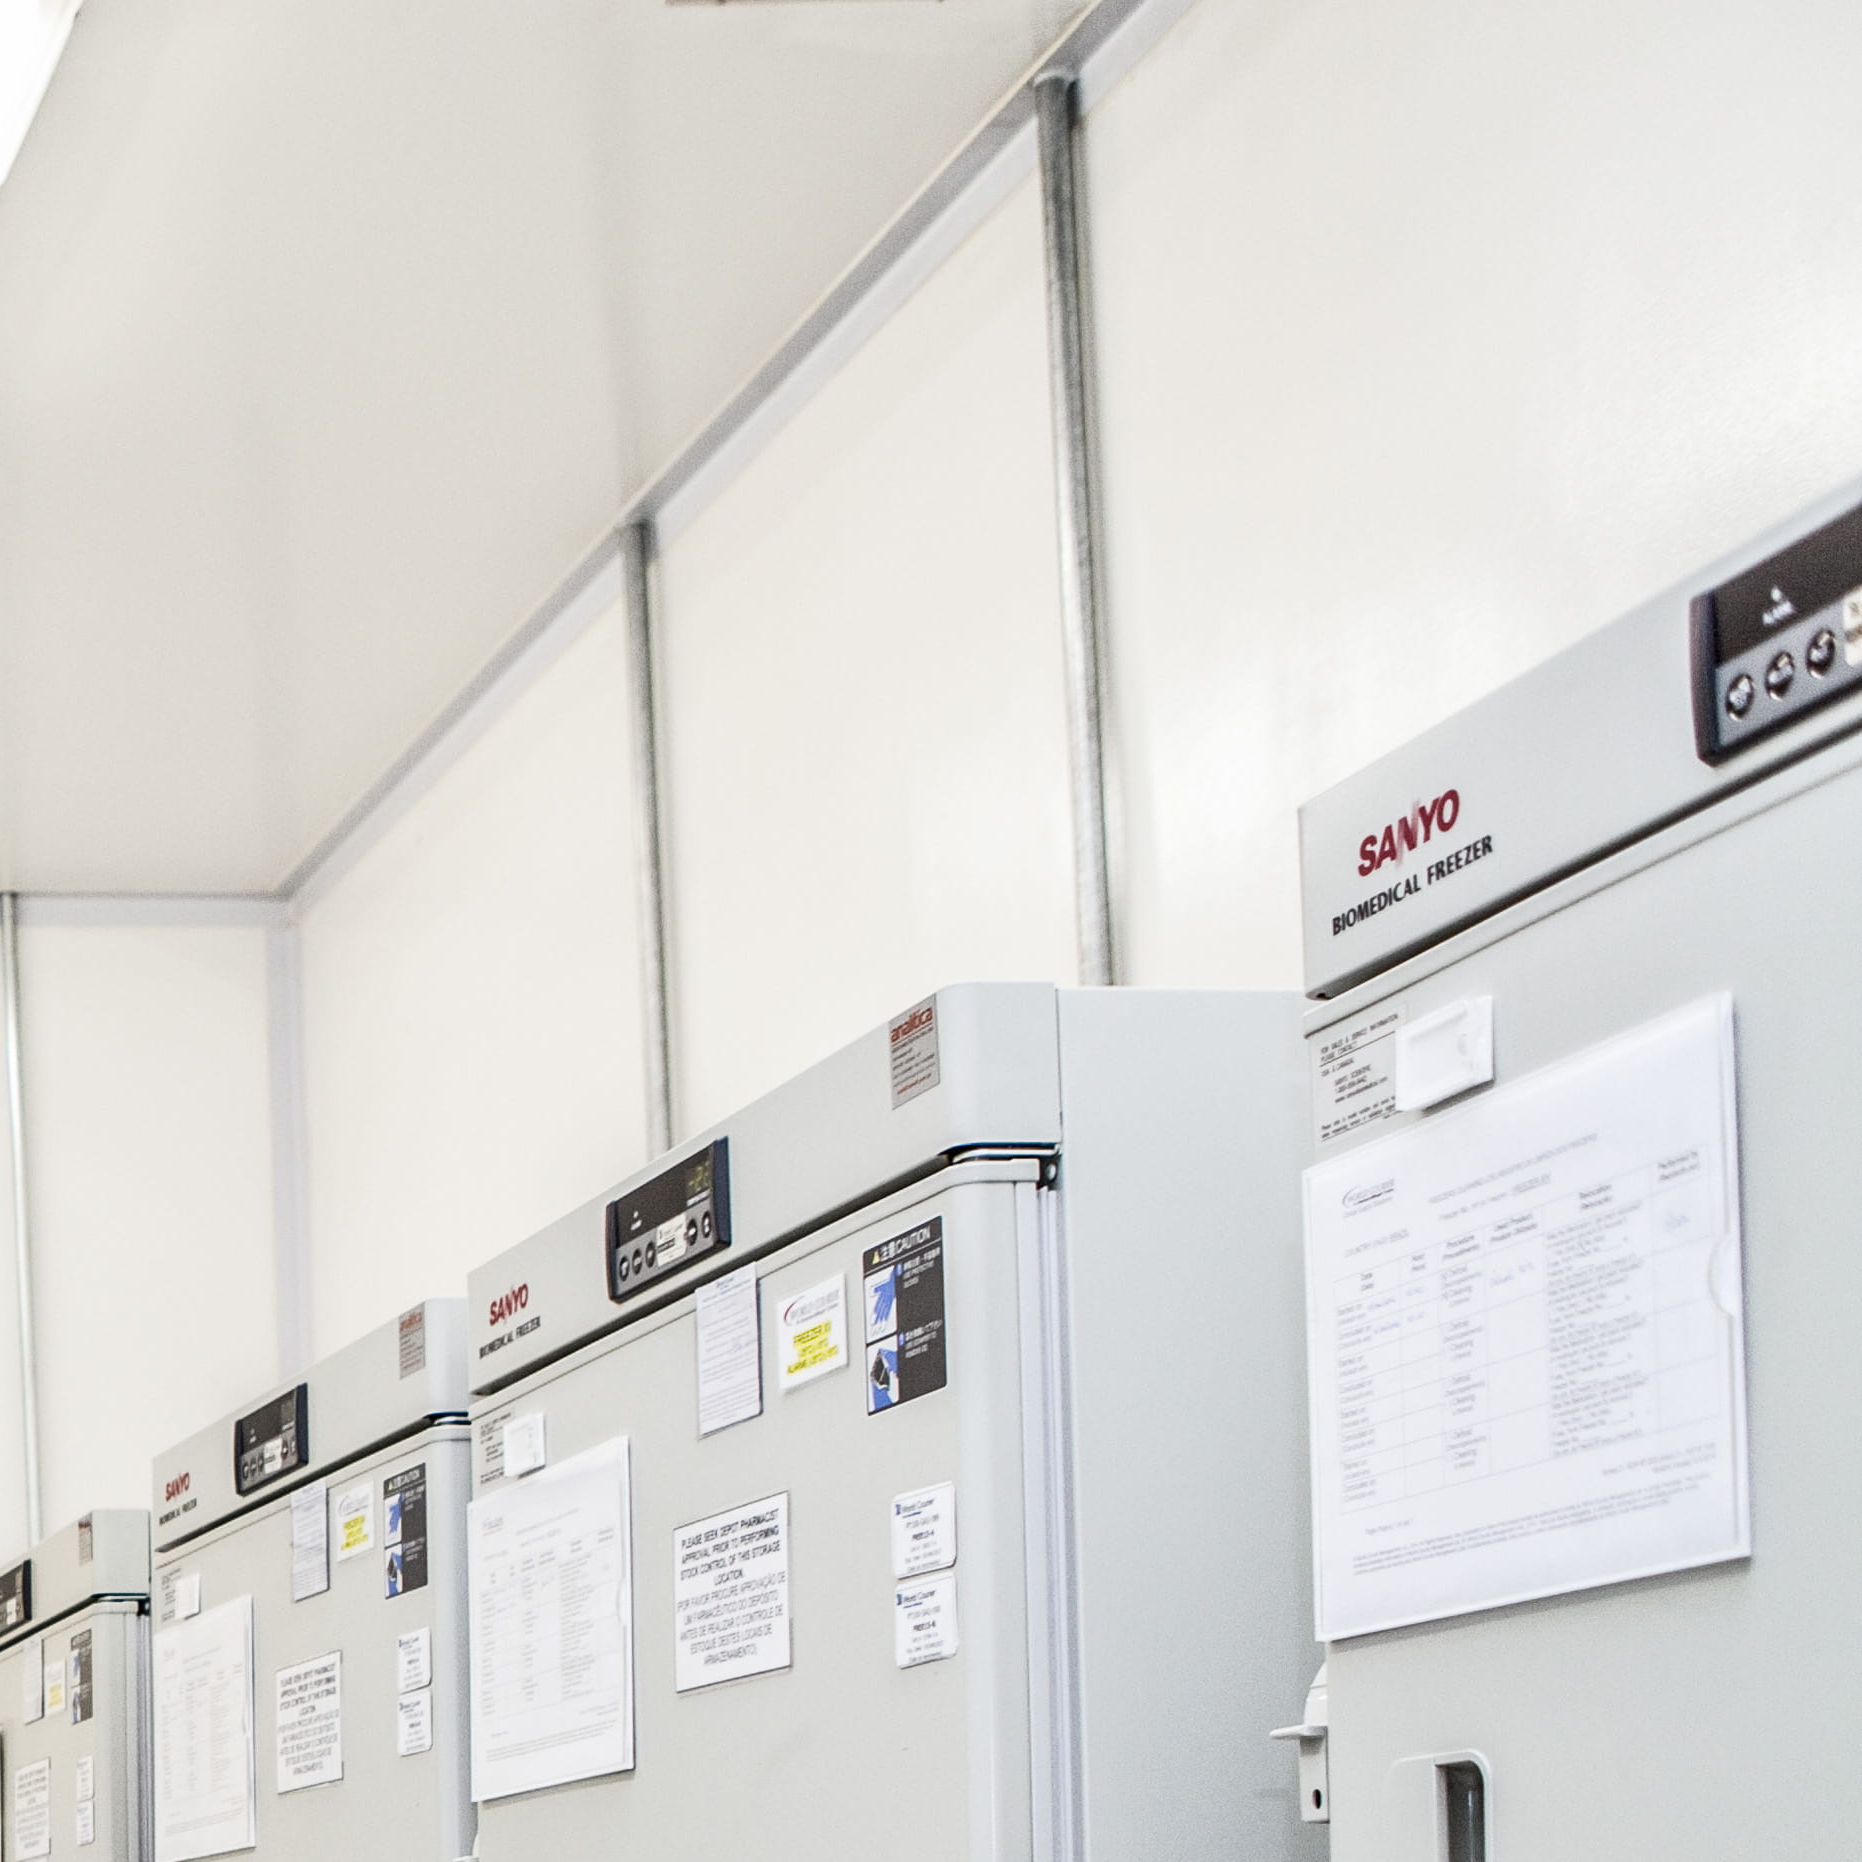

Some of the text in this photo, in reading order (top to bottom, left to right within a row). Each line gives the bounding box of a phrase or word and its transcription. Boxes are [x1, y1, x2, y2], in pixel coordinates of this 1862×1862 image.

[1357, 789, 1460, 877] SANYO
[1331, 834, 1494, 936] BIOMEDICAL FREEZER
[489, 1283, 529, 1326] SANYO
[515, 1315, 541, 1339] FREEZER
[165, 1471, 191, 1501] SANYO
